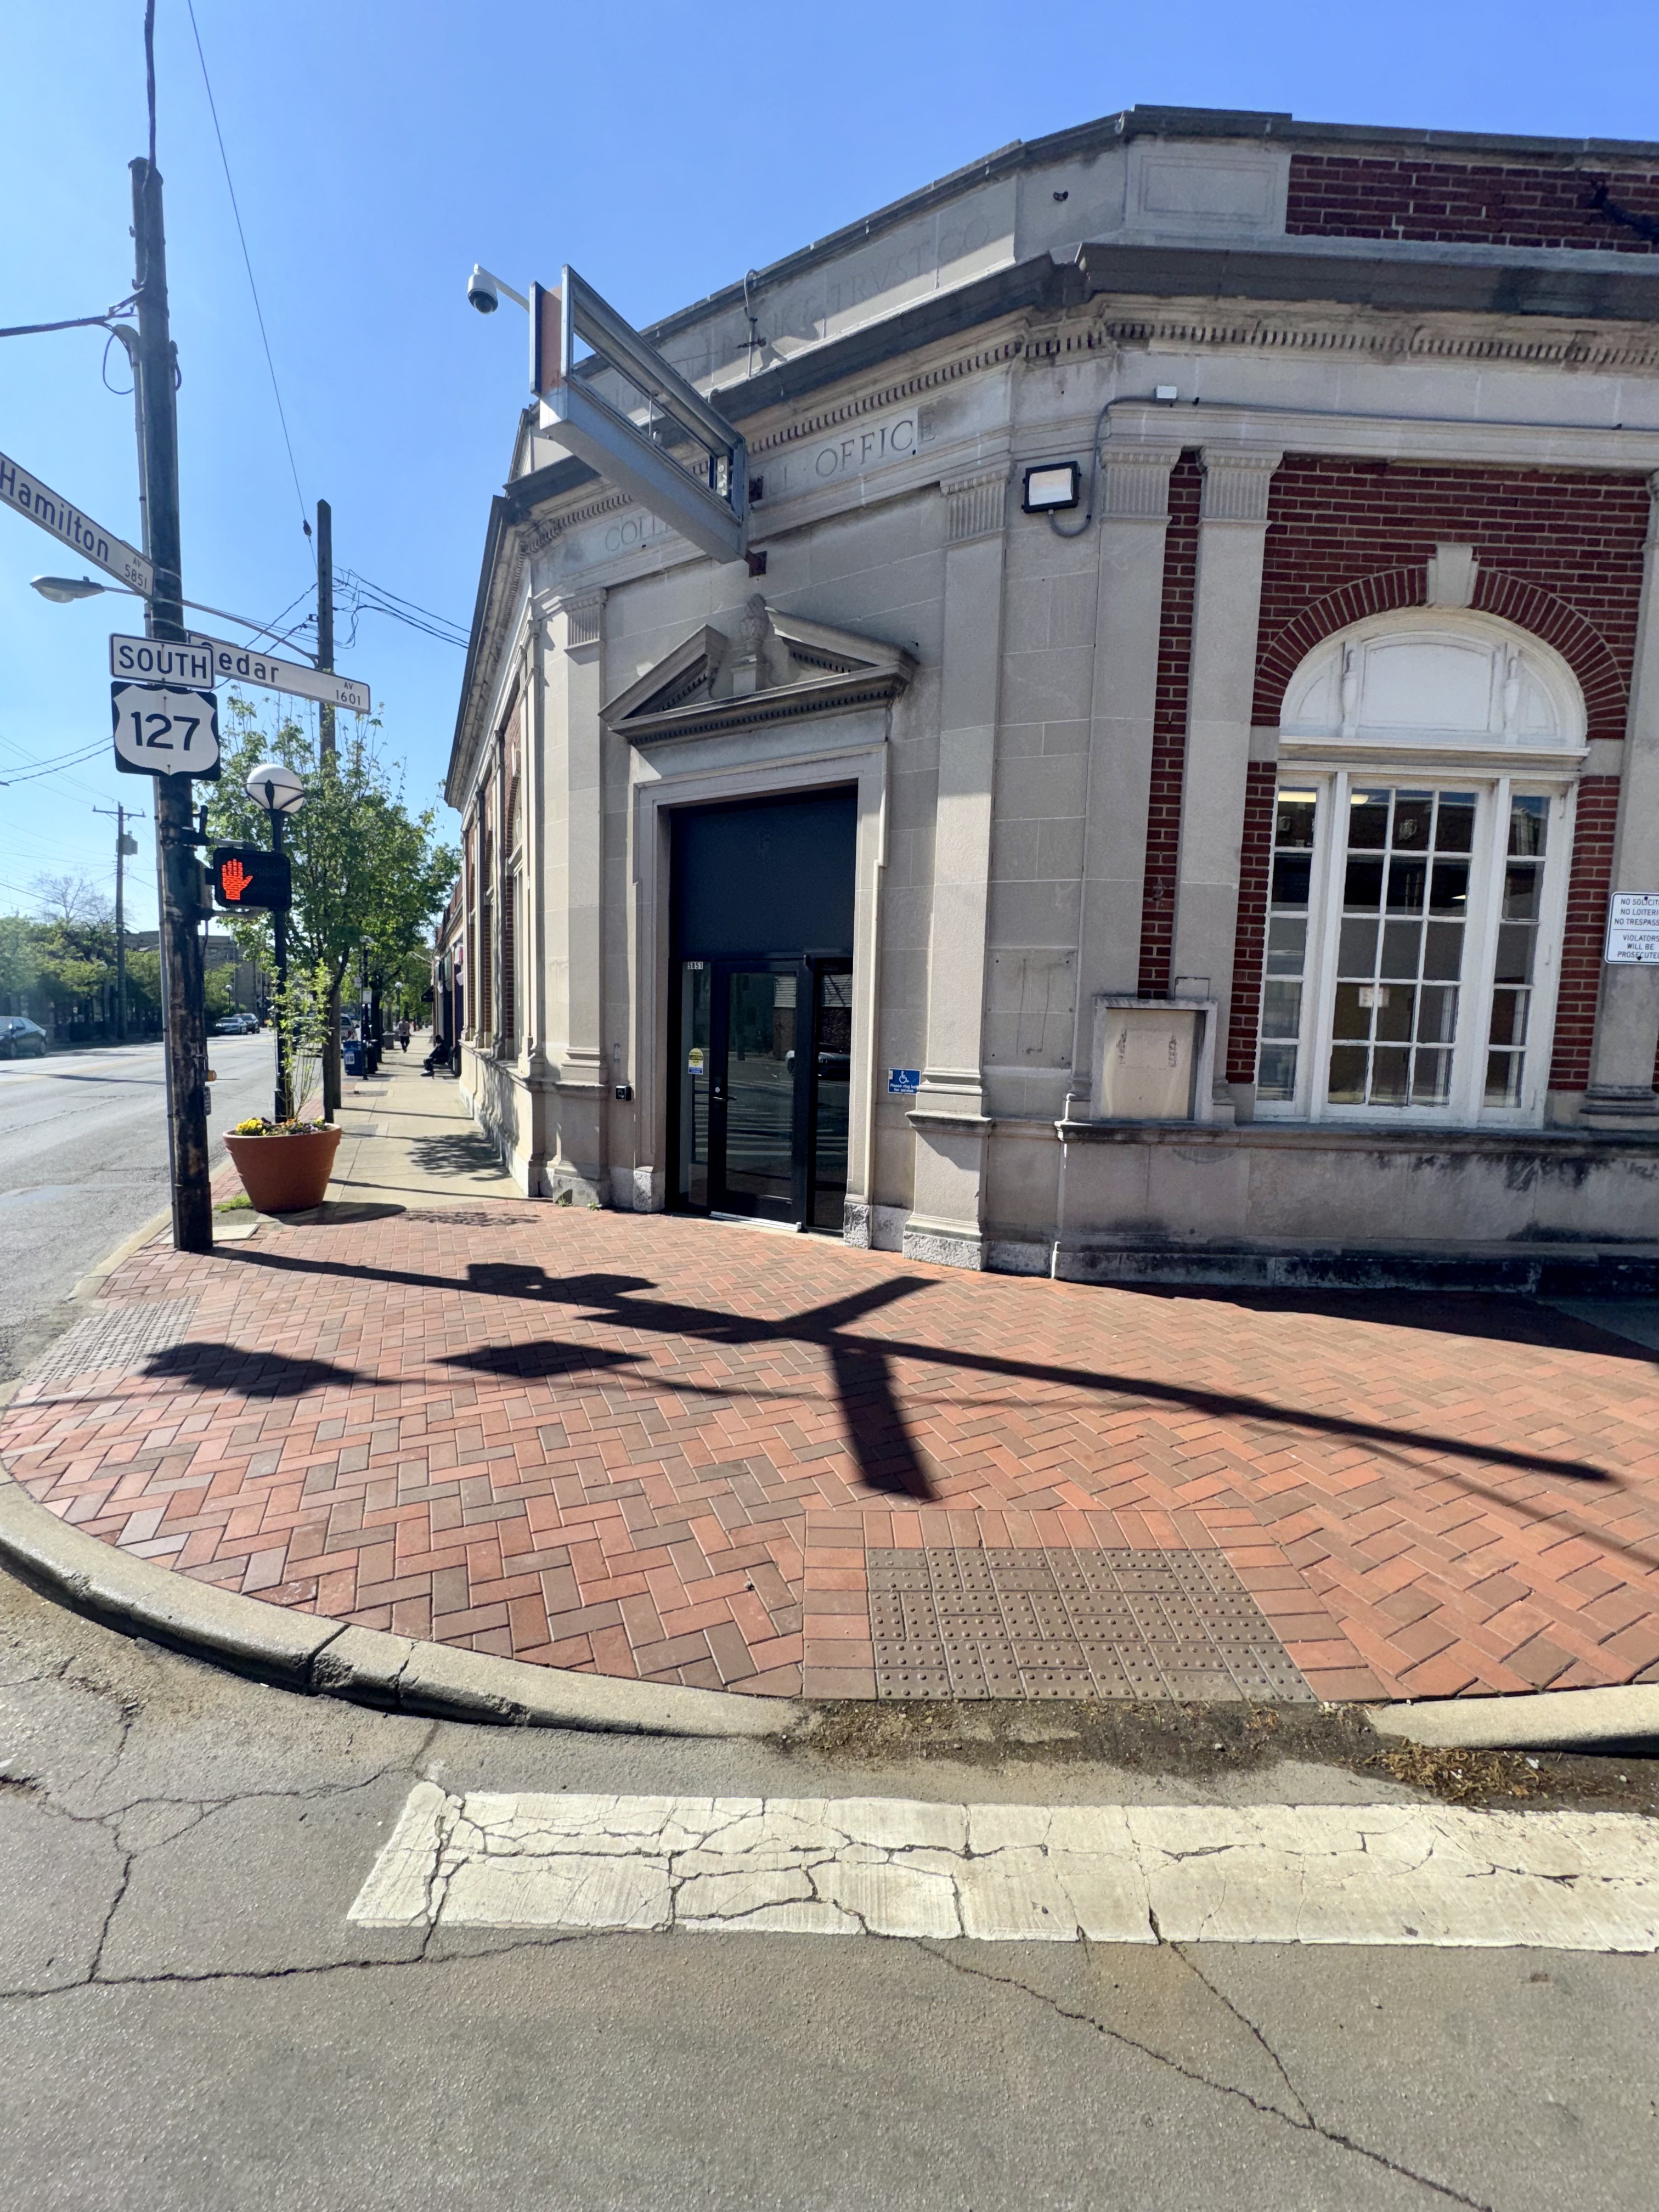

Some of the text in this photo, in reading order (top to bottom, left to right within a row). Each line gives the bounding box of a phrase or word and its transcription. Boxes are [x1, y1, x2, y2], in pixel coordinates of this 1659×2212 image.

[815, 413, 936, 478] OFFICE
[0, 460, 109, 562] Hamilton
[125, 564, 147, 590] 5851
[133, 557, 142, 568] AV
[119, 645, 207, 679] SOUTH
[201, 641, 279, 683] edar
[336, 690, 361, 706] 1601
[343, 681, 354, 690] AV
[131, 711, 201, 751] 127
